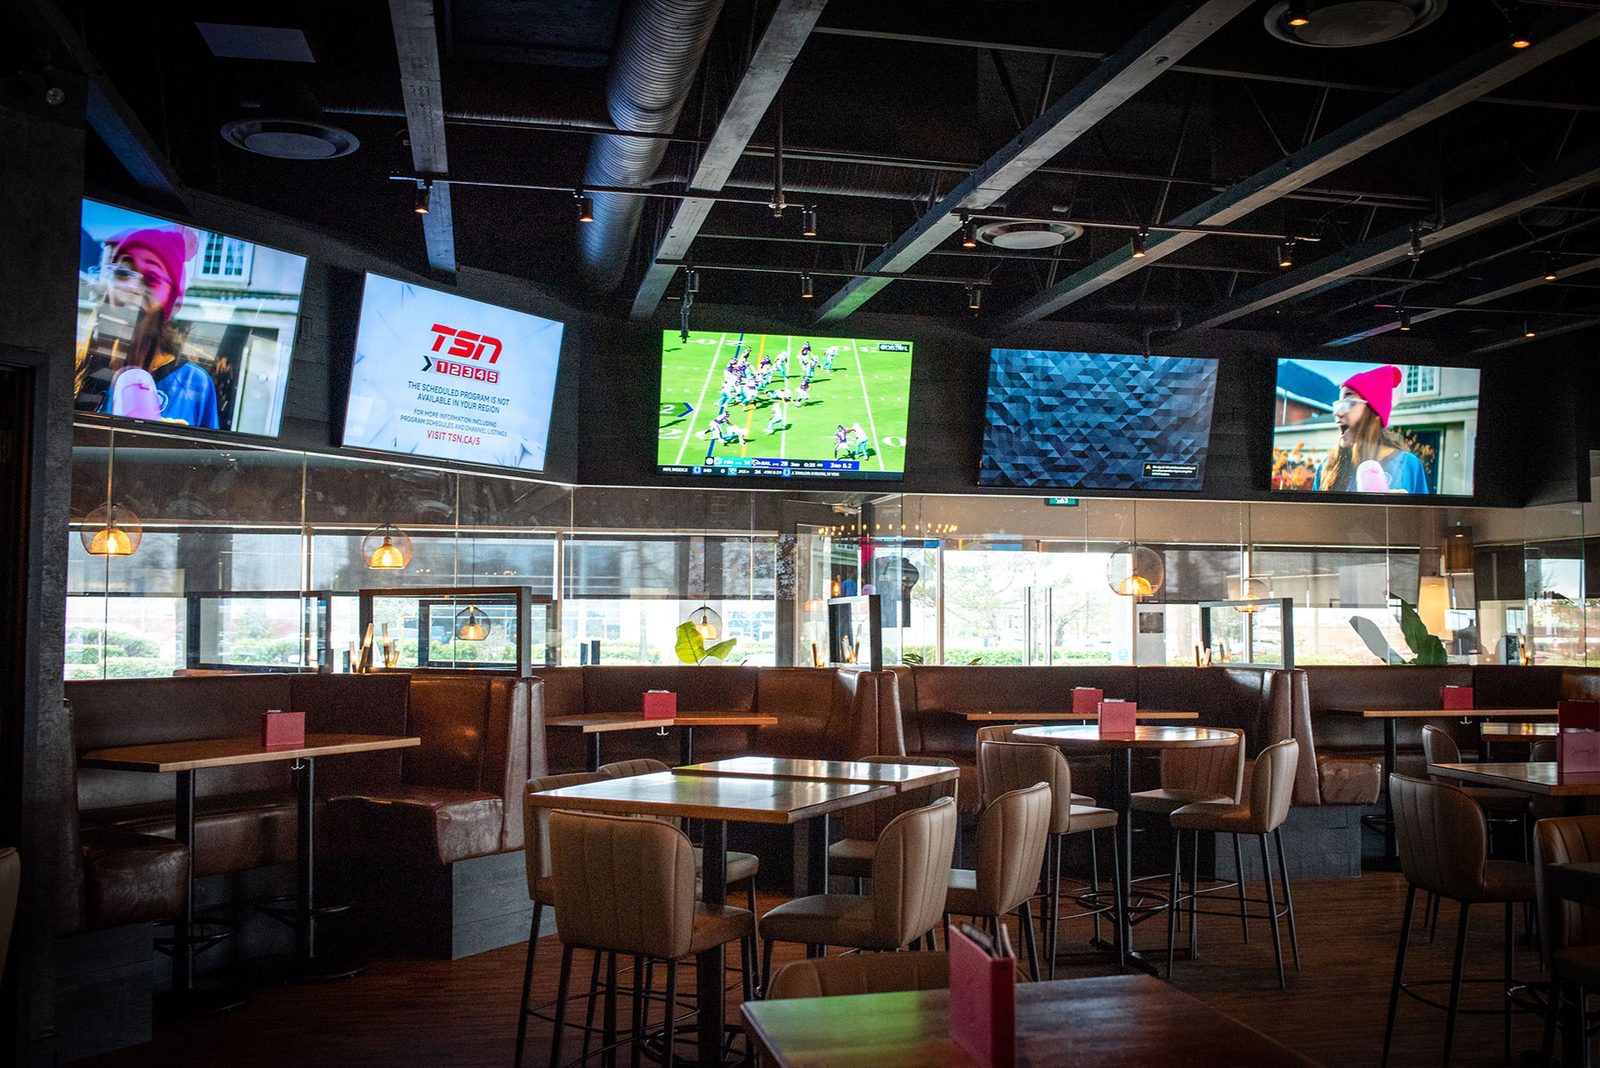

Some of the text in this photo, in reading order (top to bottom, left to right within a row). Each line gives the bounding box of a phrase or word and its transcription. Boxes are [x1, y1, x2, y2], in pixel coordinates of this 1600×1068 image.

[431, 323, 503, 364] TSN
[408, 380, 511, 406] THE SCHEDULED PROGRAM IS NOT
[417, 392, 500, 414] AVAILABLE IN YOUR REGION
[400, 414, 508, 438] PROGRAM SCHEDULES AND CHANNEL LISTINGS
[414, 408, 497, 428] FOR MORE INFORMATION INCLUDING
[427, 429, 447, 441] VISIT
